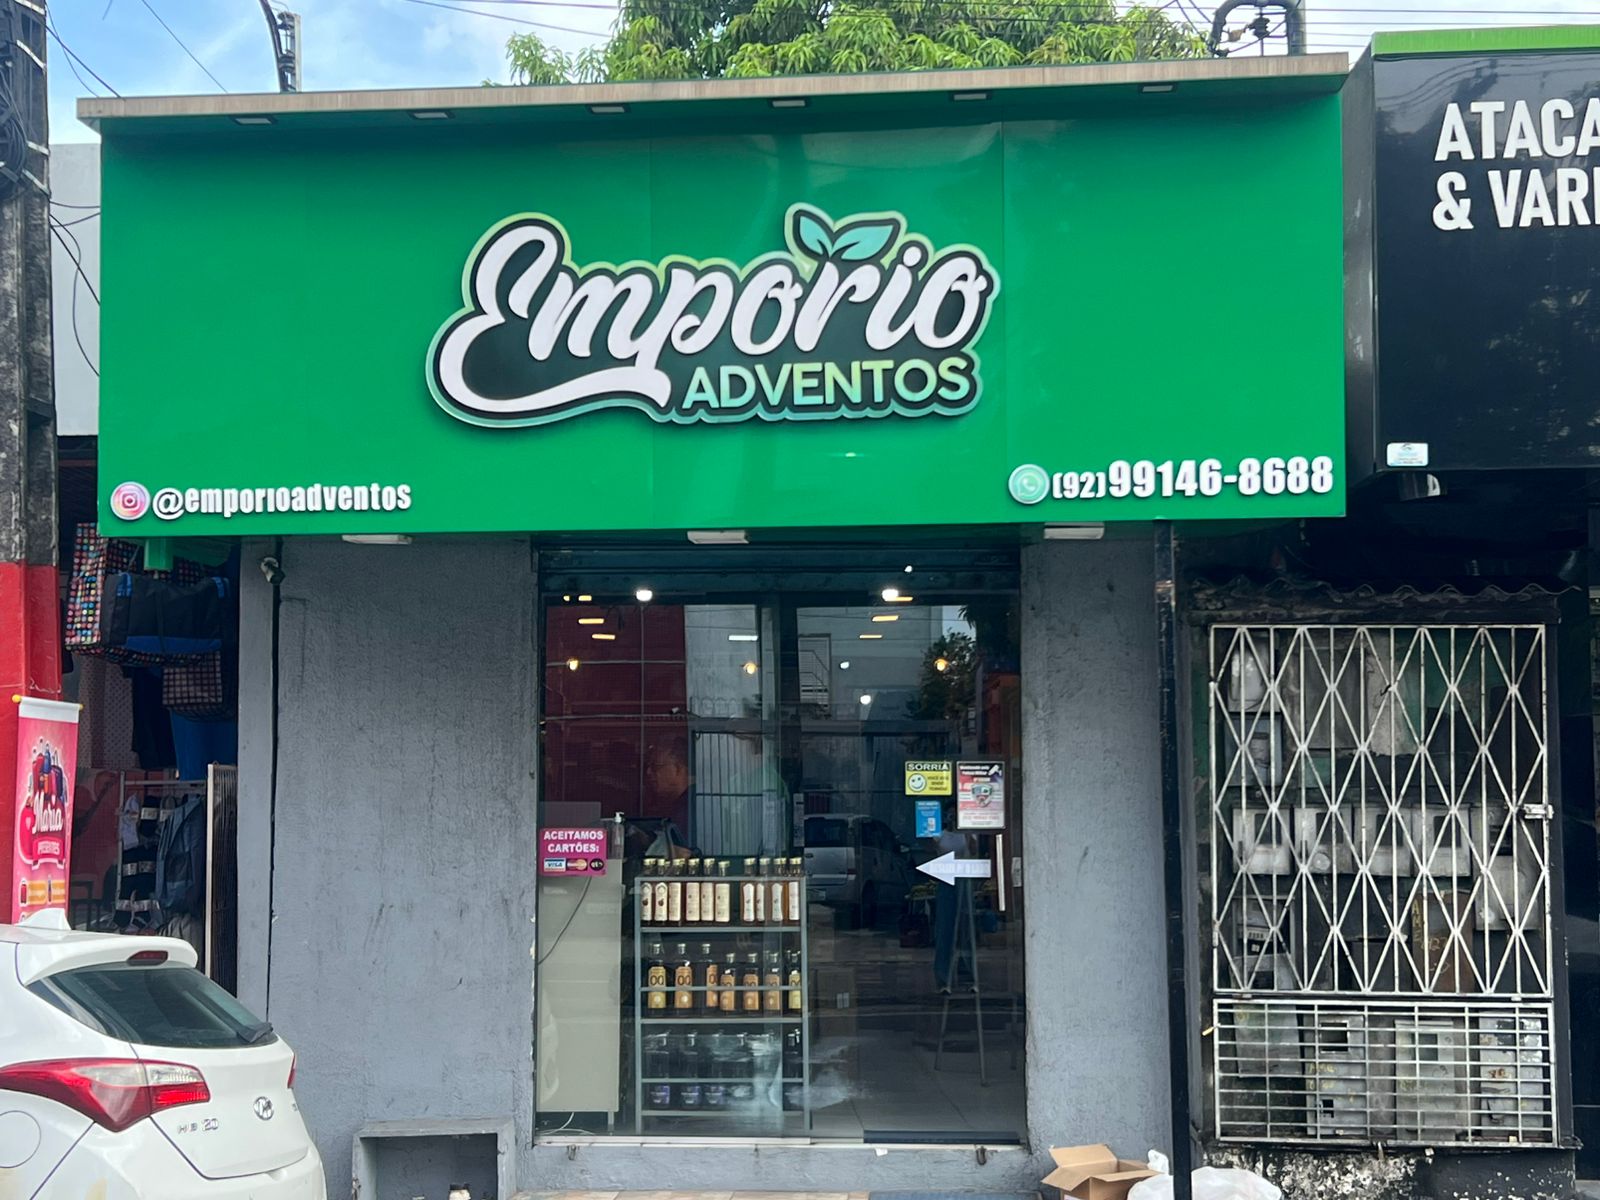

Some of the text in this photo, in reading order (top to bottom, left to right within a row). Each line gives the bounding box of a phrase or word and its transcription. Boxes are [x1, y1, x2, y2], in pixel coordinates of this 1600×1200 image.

[1432, 171, 1474, 231] &
[682, 357, 970, 410] ADVENTOS
[152, 483, 412, 520] @emporioadventos
[908, 763, 949, 771] SORRIA
[32, 791, 63, 834] Maria
[544, 830, 604, 840] ACEITAMOS
